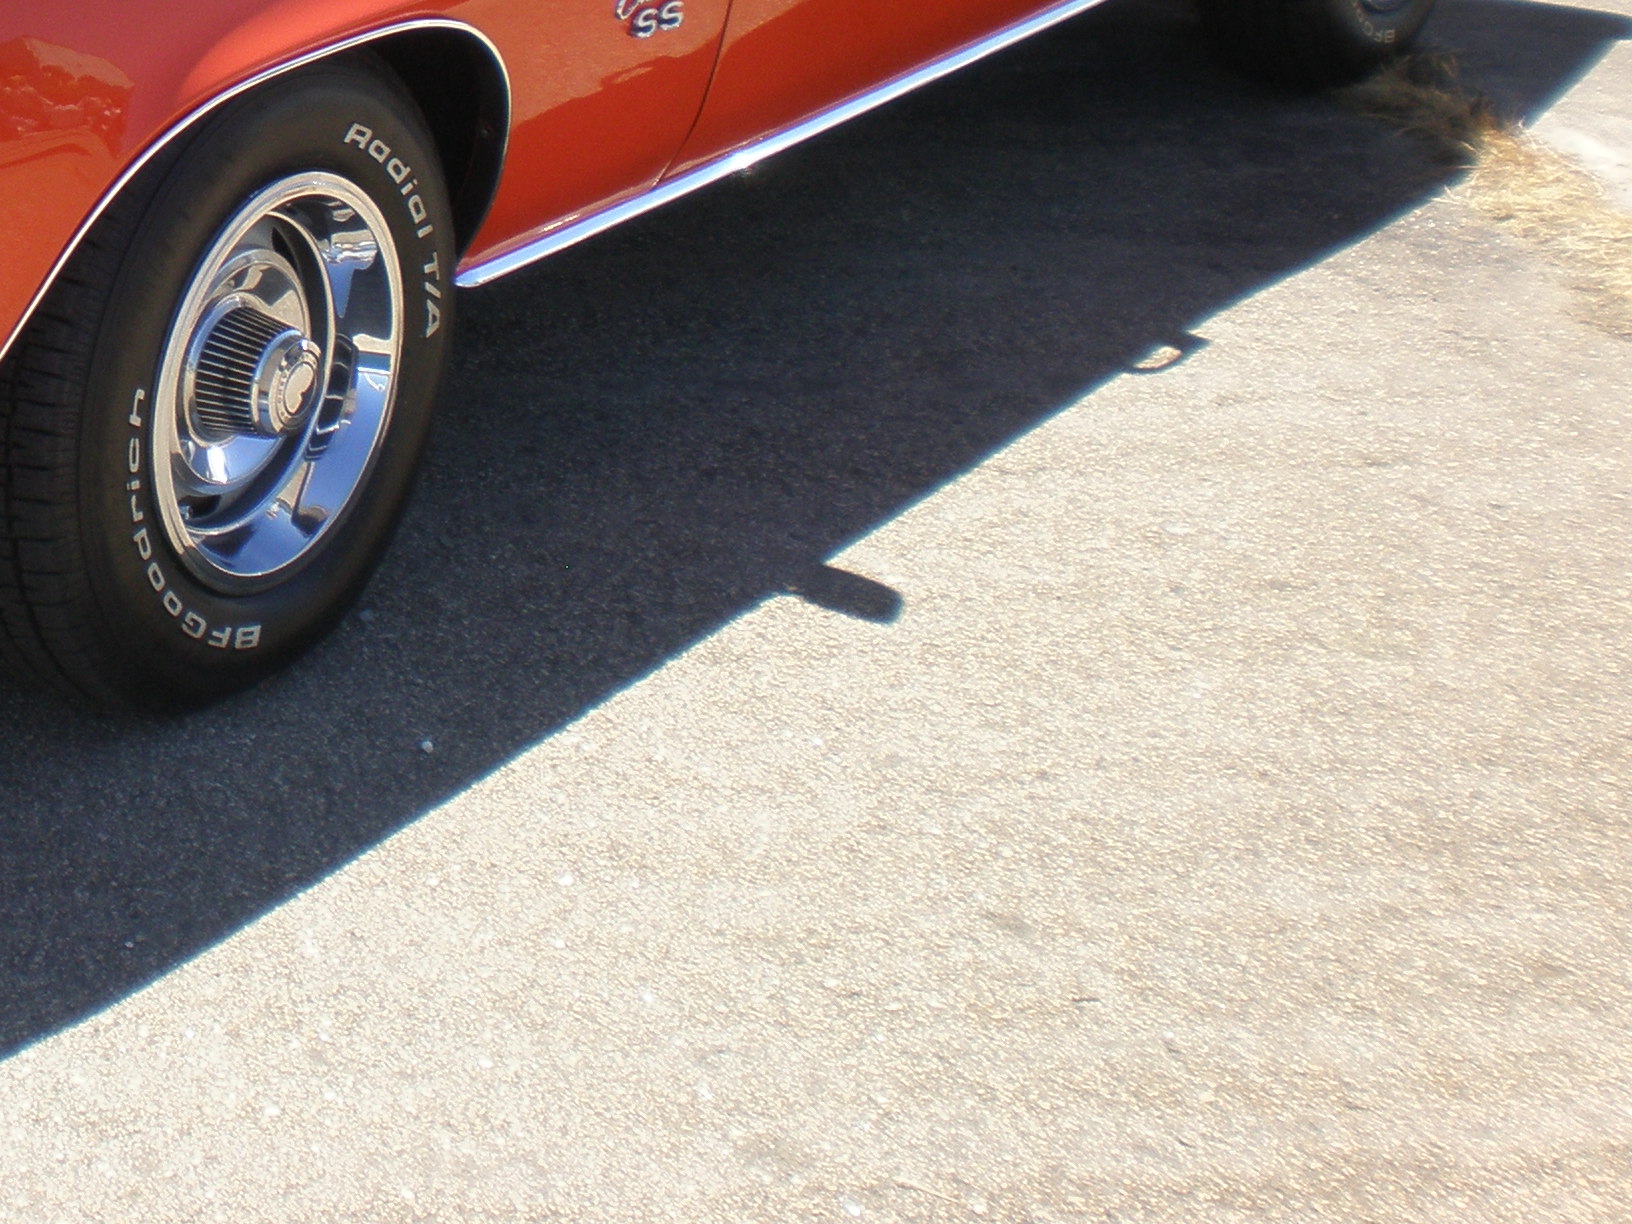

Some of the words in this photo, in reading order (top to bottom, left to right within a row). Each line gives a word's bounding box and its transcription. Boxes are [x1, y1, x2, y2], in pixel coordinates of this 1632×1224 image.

[632, 1, 684, 38] SS
[344, 123, 434, 239] Radial
[424, 251, 442, 339] T/A
[126, 388, 262, 651] BFGoodrich
